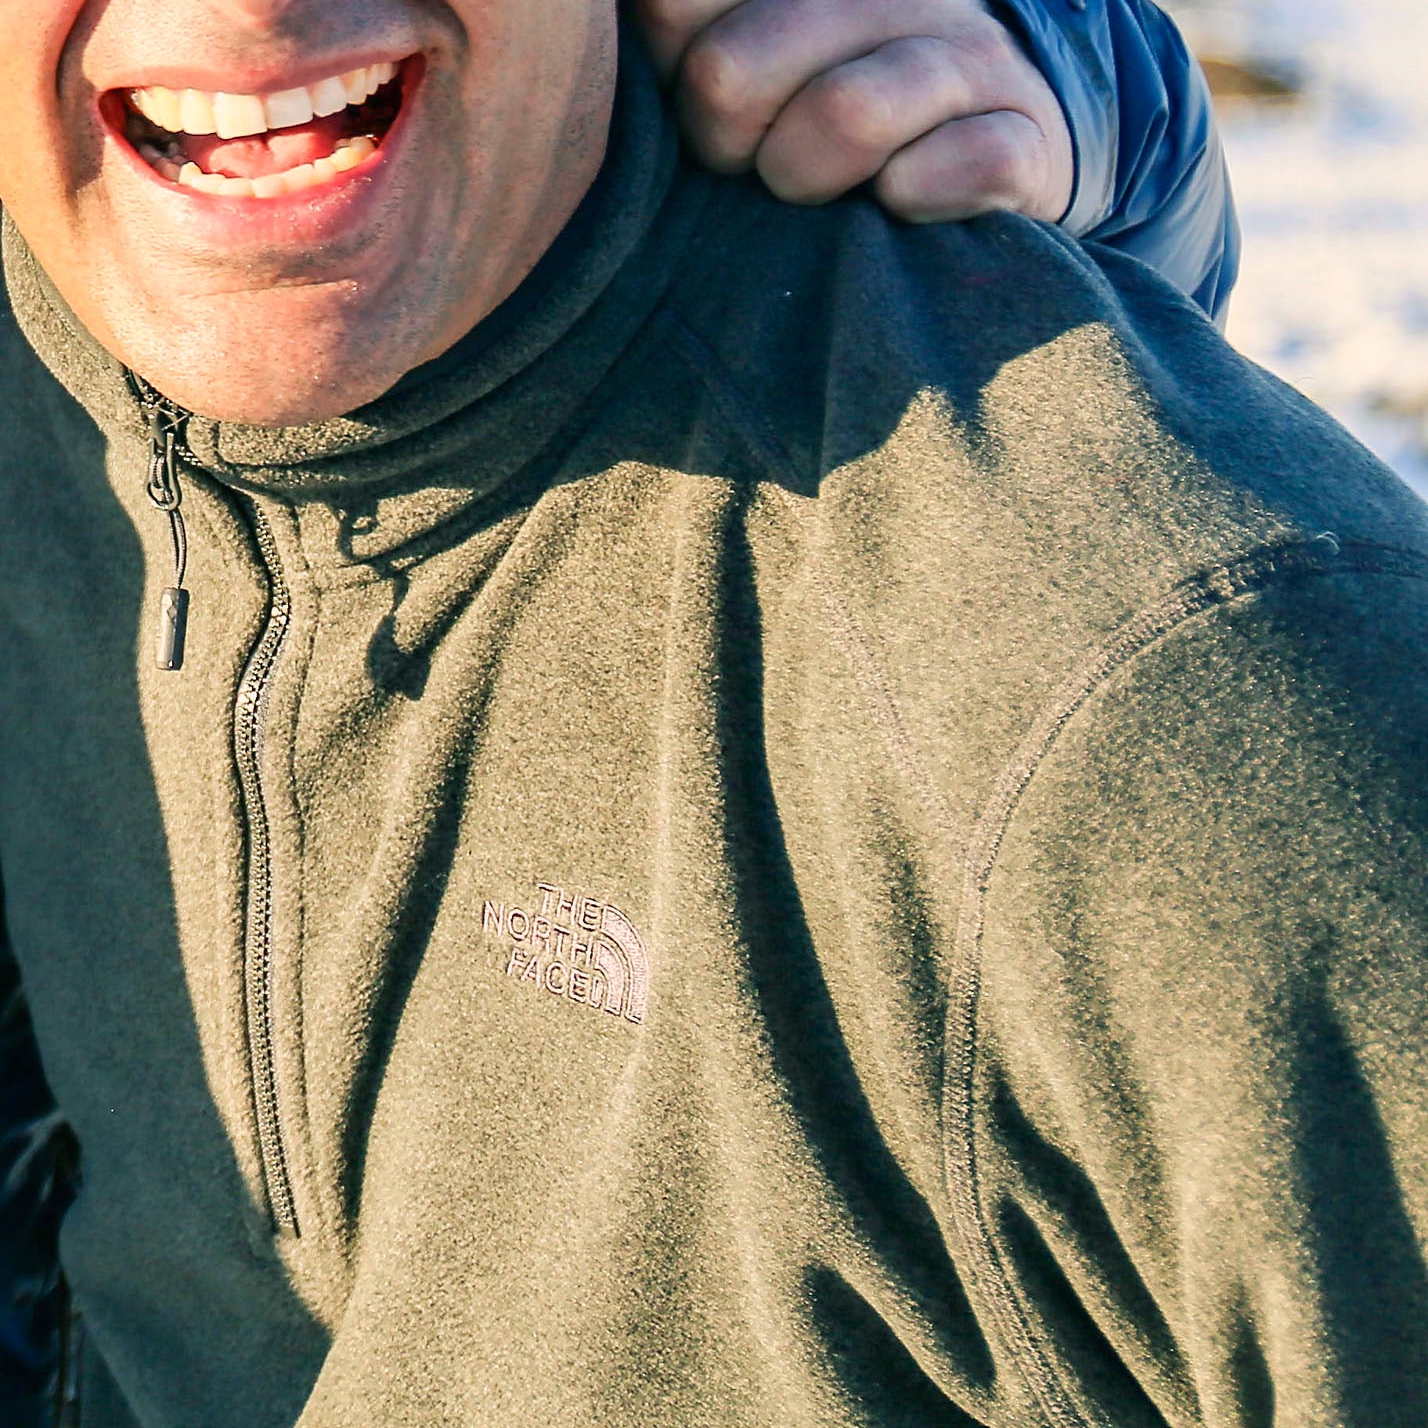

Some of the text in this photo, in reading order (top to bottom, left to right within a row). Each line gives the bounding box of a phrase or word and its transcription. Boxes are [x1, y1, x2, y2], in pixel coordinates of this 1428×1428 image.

[483, 900, 594, 967] NORTH
[537, 882, 601, 931] THE
[506, 947, 589, 1003] FACE
